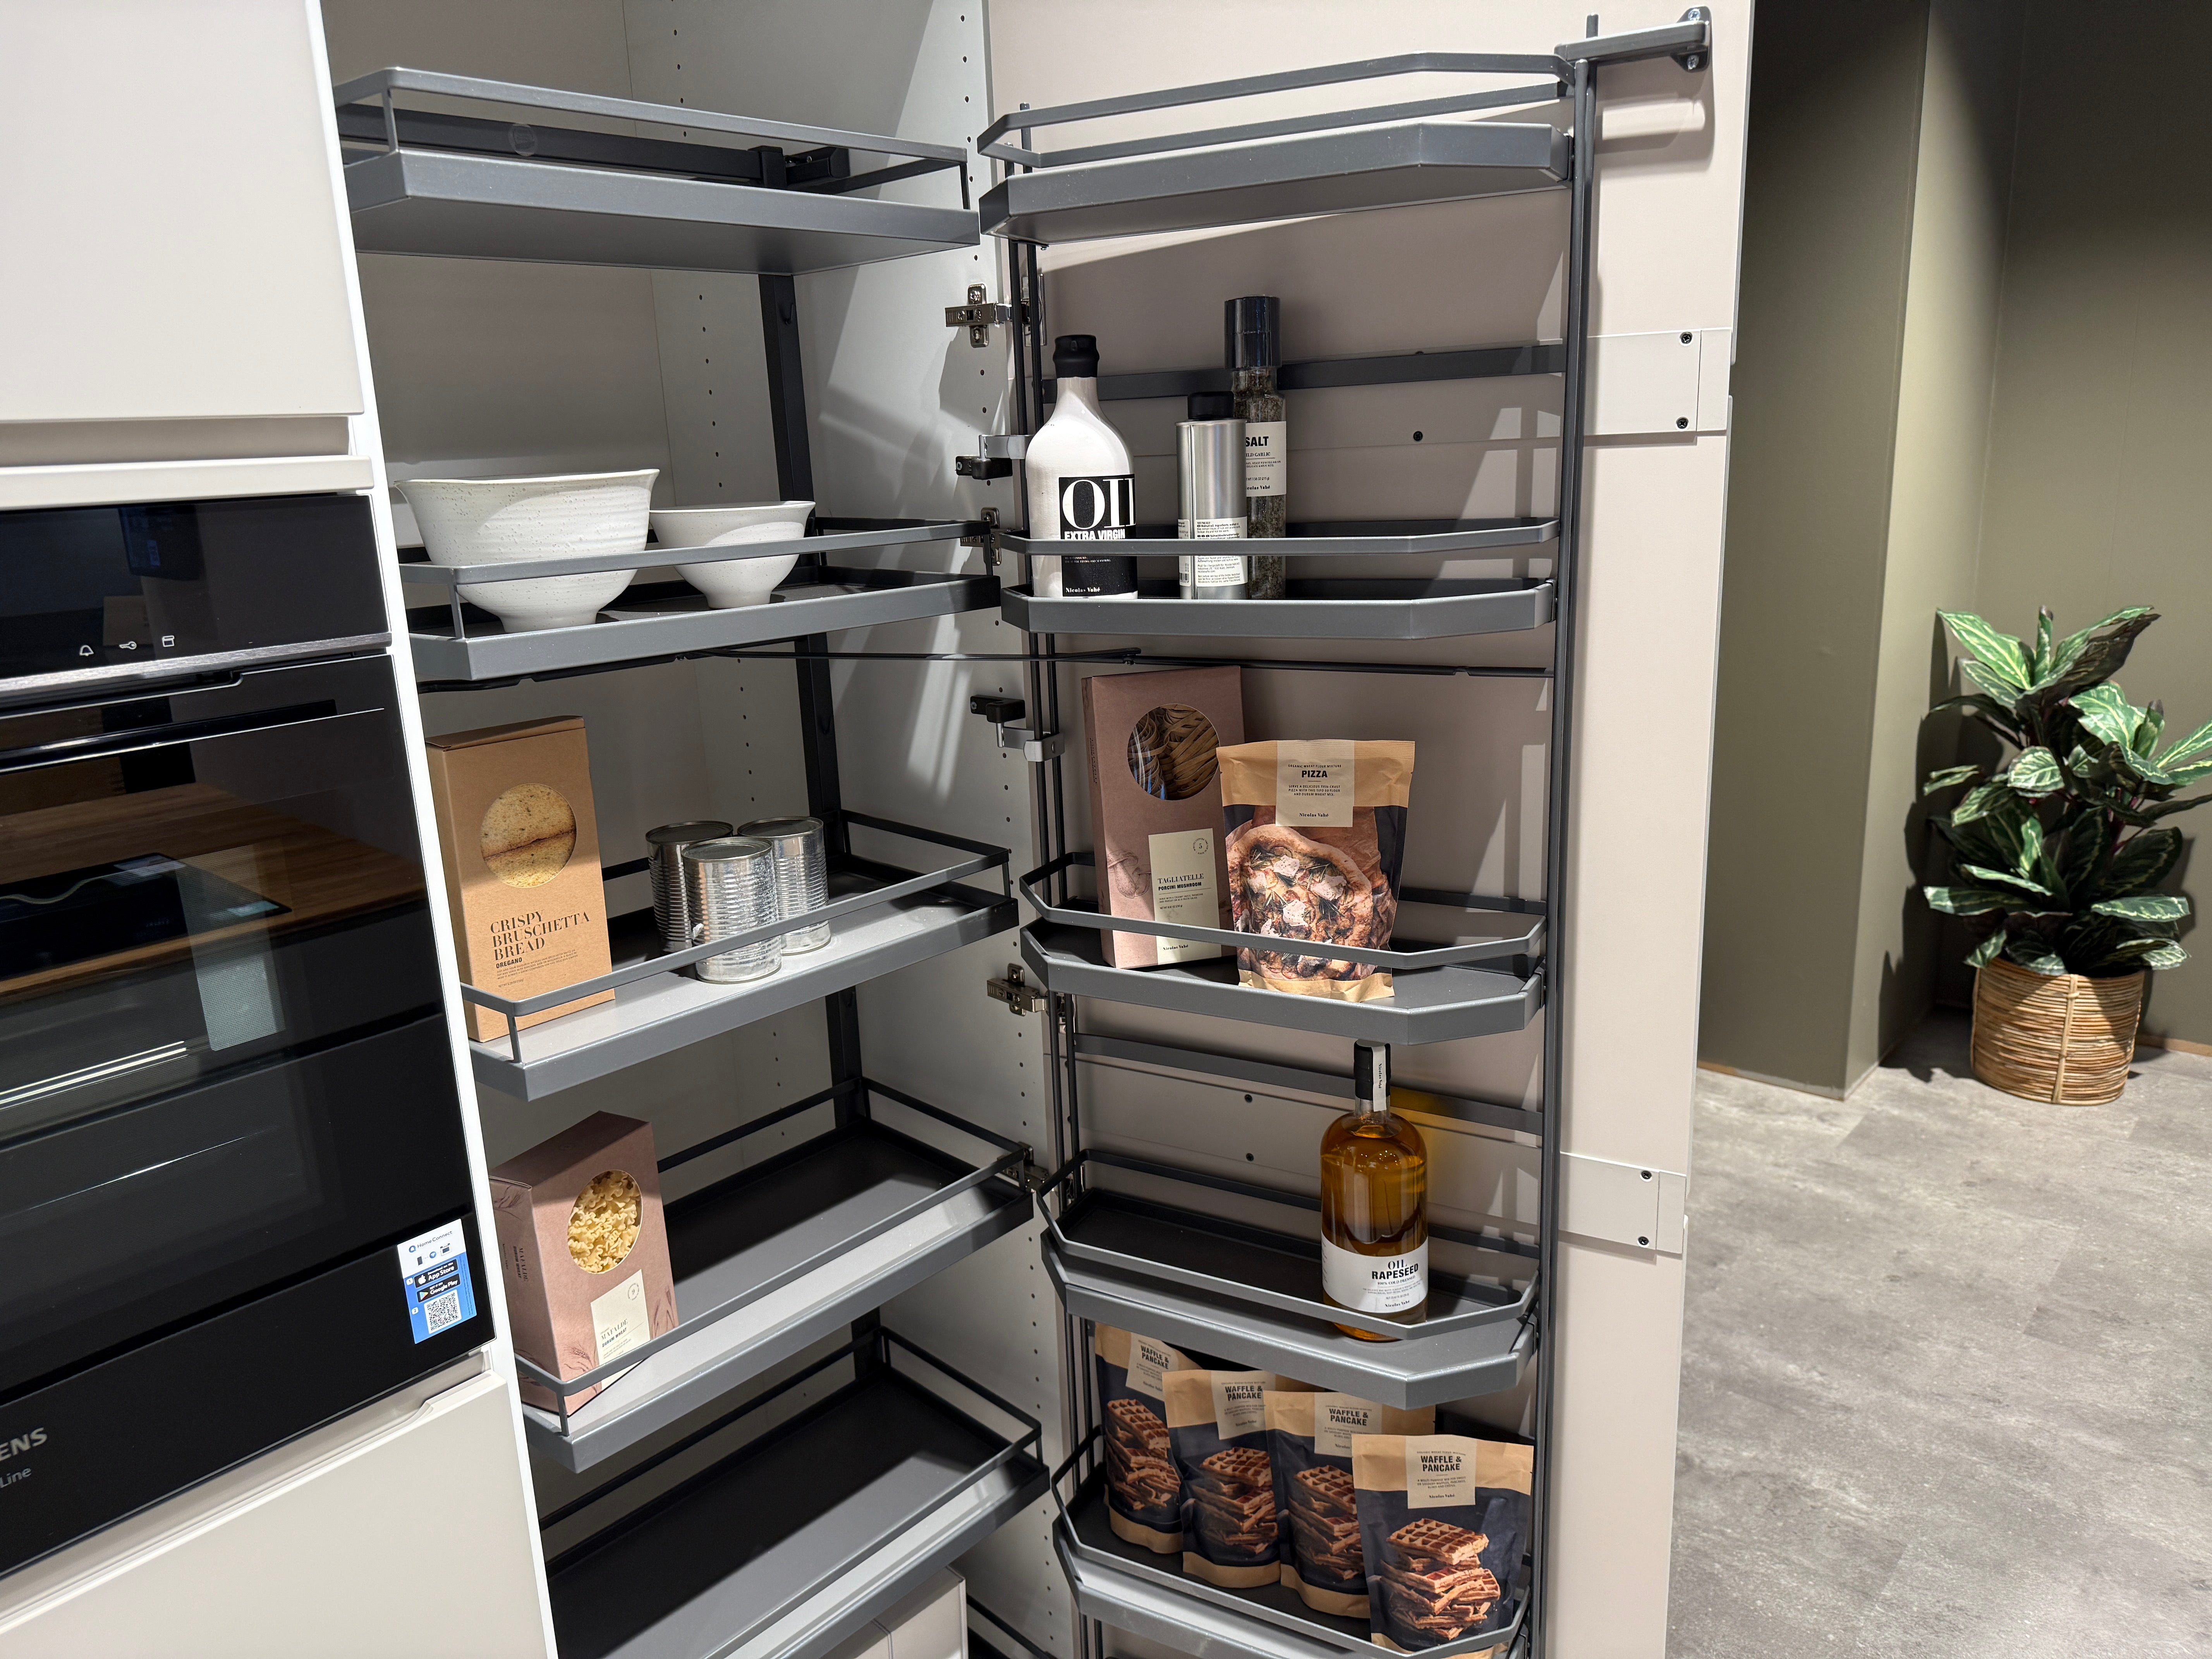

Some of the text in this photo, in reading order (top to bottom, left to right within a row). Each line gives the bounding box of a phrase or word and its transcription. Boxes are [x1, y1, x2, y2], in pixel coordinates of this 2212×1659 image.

[1246, 436, 1269, 447] SALT
[1064, 529, 1125, 540] EXTRA VIRGIN
[1302, 770, 1328, 778] PIZZA
[1158, 873, 1204, 884] TAGLIATELLE
[490, 910, 544, 934] CRISPY
[492, 911, 591, 948] BRUSCHETTA
[494, 937, 545, 961] BREAD
[496, 957, 522, 969] OREGANO
[417, 1231, 453, 1248] Home Connect
[519, 1248, 528, 1281] MAFALDE
[1388, 1259, 1407, 1270] OIL
[428, 1266, 455, 1281] App Store
[1372, 1263, 1419, 1279] RAPESEED
[1400, 1275, 1415, 1283] PRESSED
[430, 1284, 448, 1295] Google
[601, 1319, 628, 1340] MAFALDE
[615, 1327, 627, 1338] WHEAT
[1140, 1345, 1163, 1360] WAFFLE
[1142, 1352, 1169, 1369] PANCAKE
[1227, 1392, 1262, 1401] PANCAKE
[1329, 1408, 1360, 1417] WAFFLE
[1330, 1415, 1367, 1426] PANCAKE
[1422, 1463, 1460, 1472] PANCAKE
